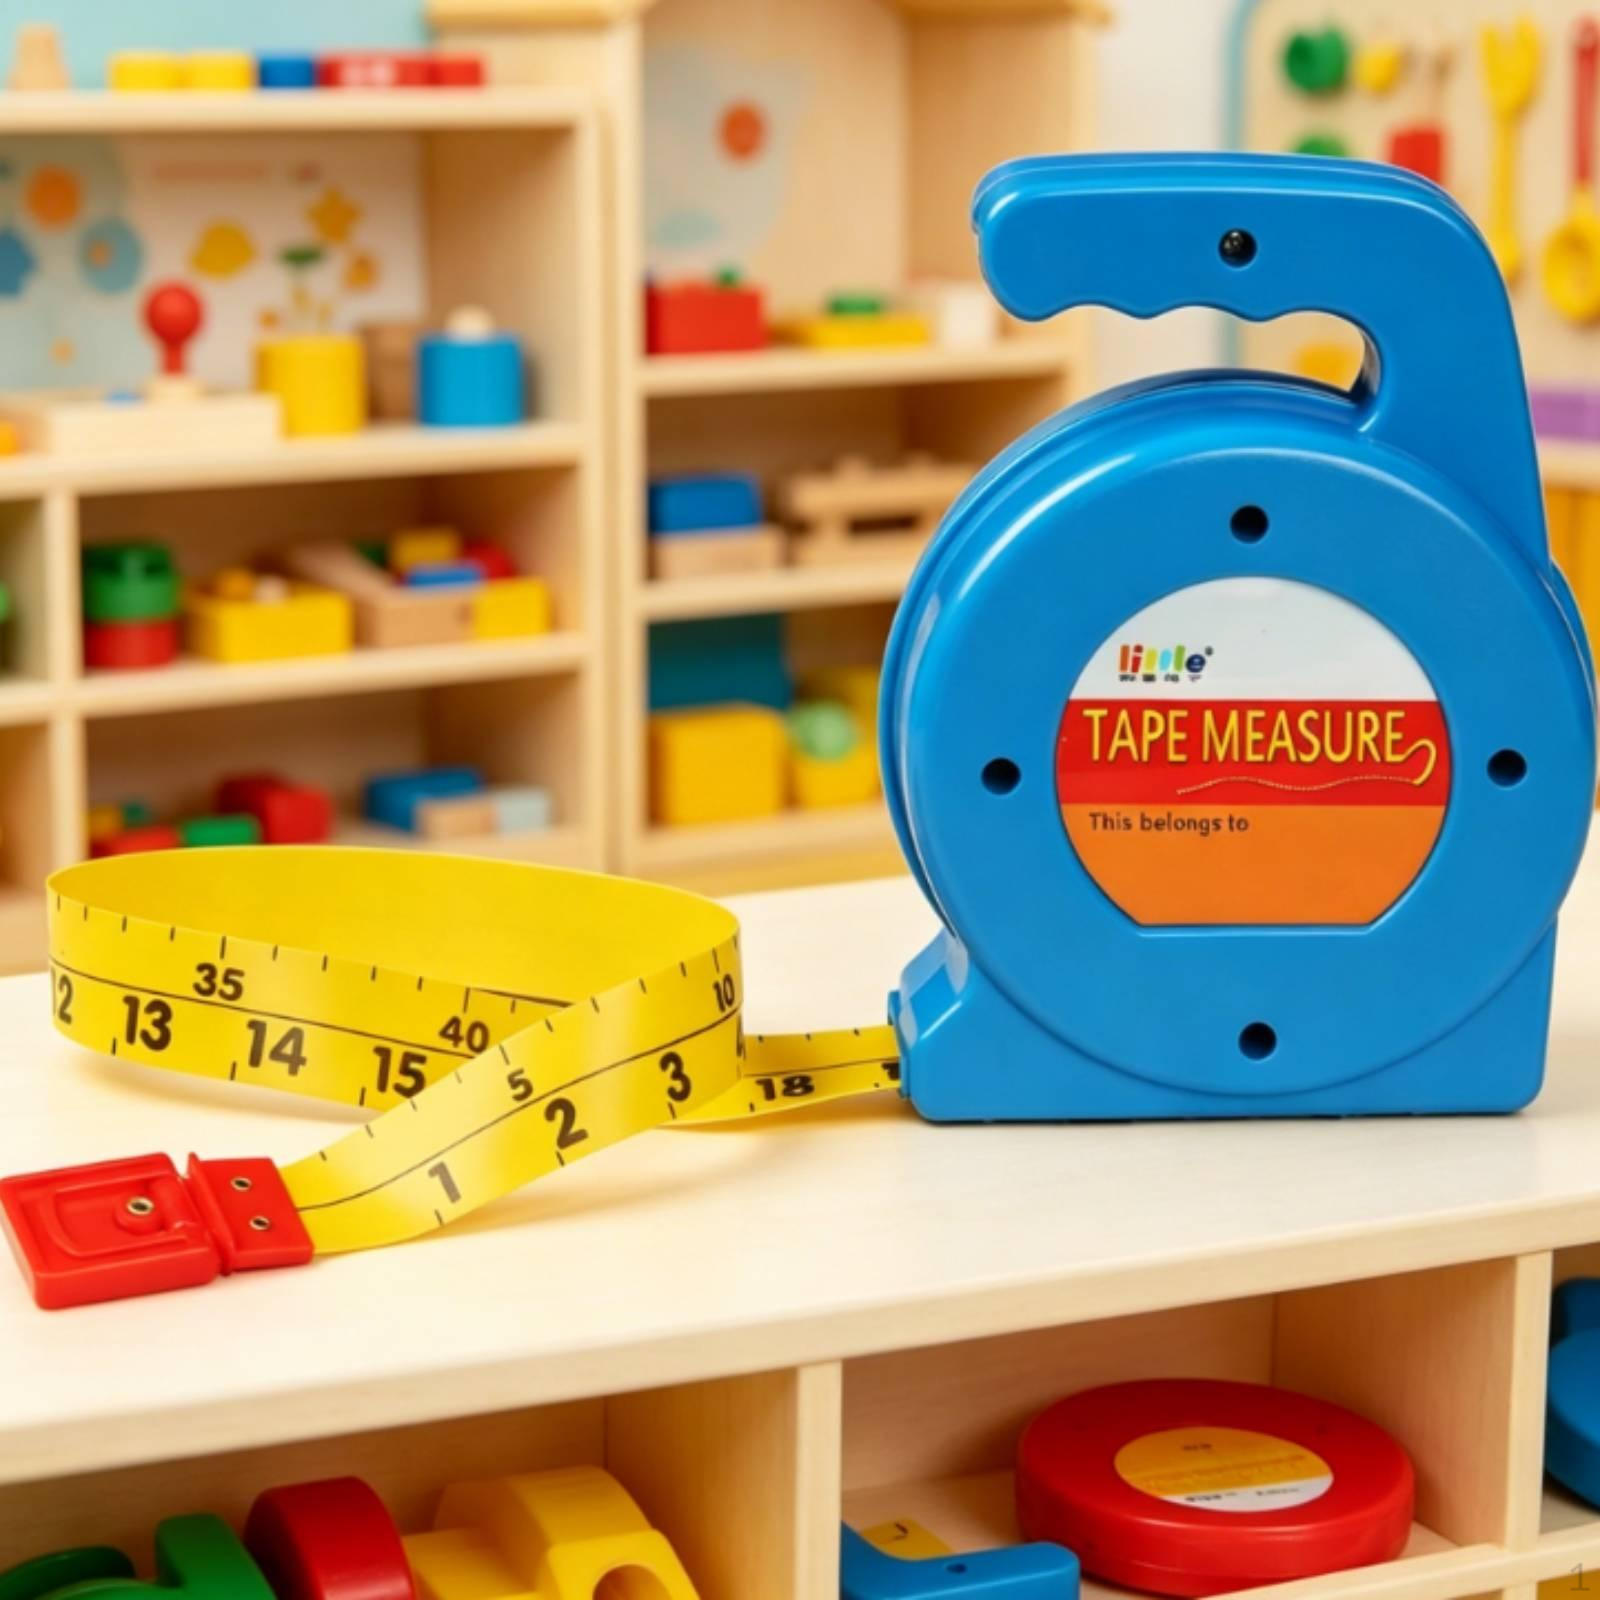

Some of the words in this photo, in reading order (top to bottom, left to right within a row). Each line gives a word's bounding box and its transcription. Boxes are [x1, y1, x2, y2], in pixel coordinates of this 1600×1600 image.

[1083, 709, 1188, 763] TAPE
[1203, 709, 1406, 763] MEASURE
[1089, 812, 1132, 832] This
[1139, 812, 1222, 837] belongs
[1228, 814, 1249, 832] to
[122, 995, 172, 1052] 13
[246, 1019, 307, 1077] 14
[372, 1045, 428, 1099] 15
[193, 962, 246, 1002] 35
[438, 1015, 490, 1054] 40
[506, 1067, 534, 1102] 5
[713, 973, 735, 1012] 10
[427, 1161, 462, 1204] 1
[545, 1098, 589, 1150] 2
[659, 1051, 692, 1102] 3
[755, 1074, 815, 1101] 18
